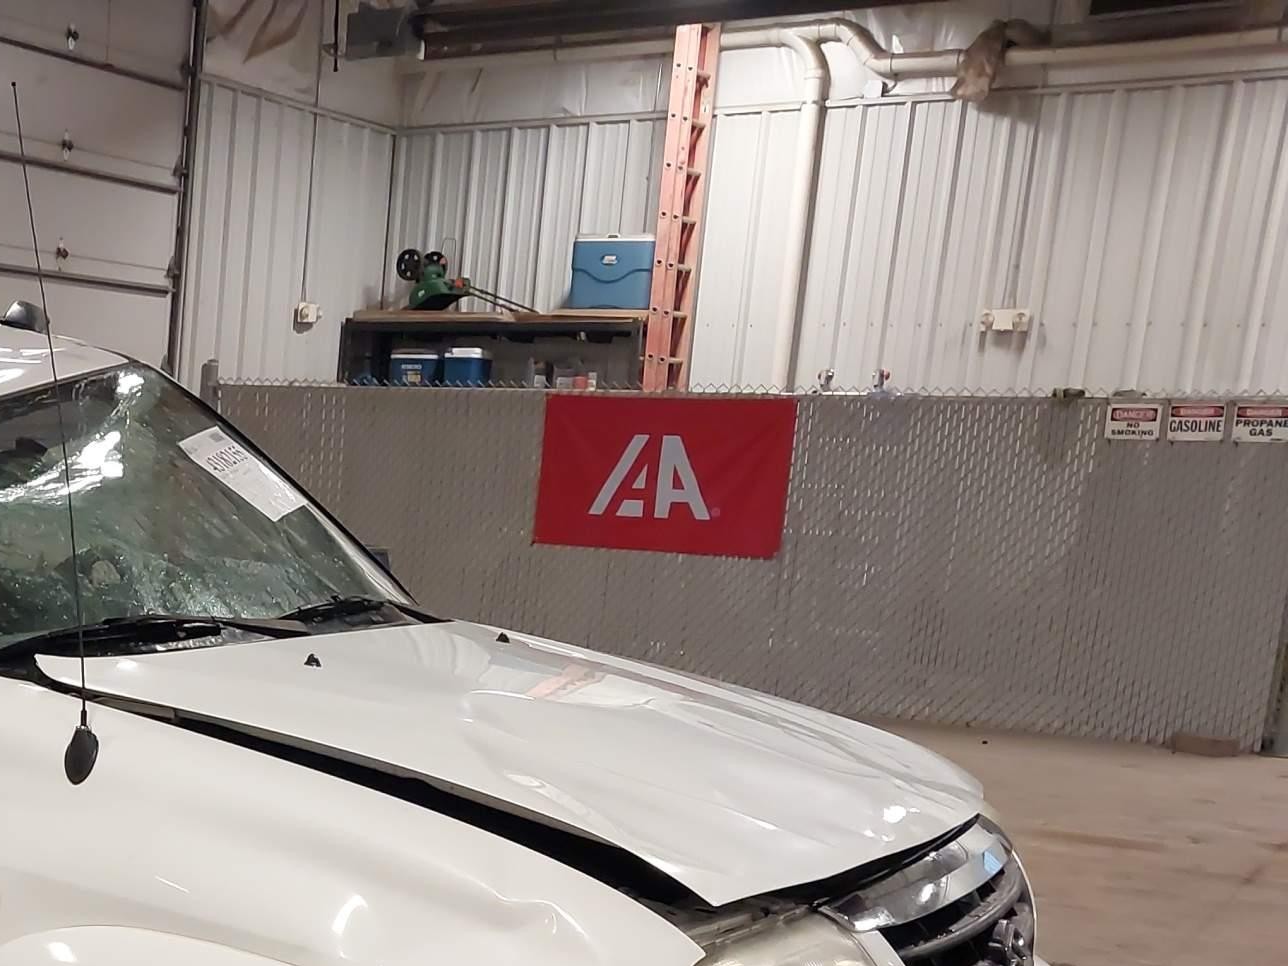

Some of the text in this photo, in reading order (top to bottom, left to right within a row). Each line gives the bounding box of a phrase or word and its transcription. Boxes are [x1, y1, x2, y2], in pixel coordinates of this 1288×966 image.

[1169, 419, 1223, 433] GASOLINE
[1111, 429, 1154, 437] SMOKING
[1249, 428, 1273, 437] GAS
